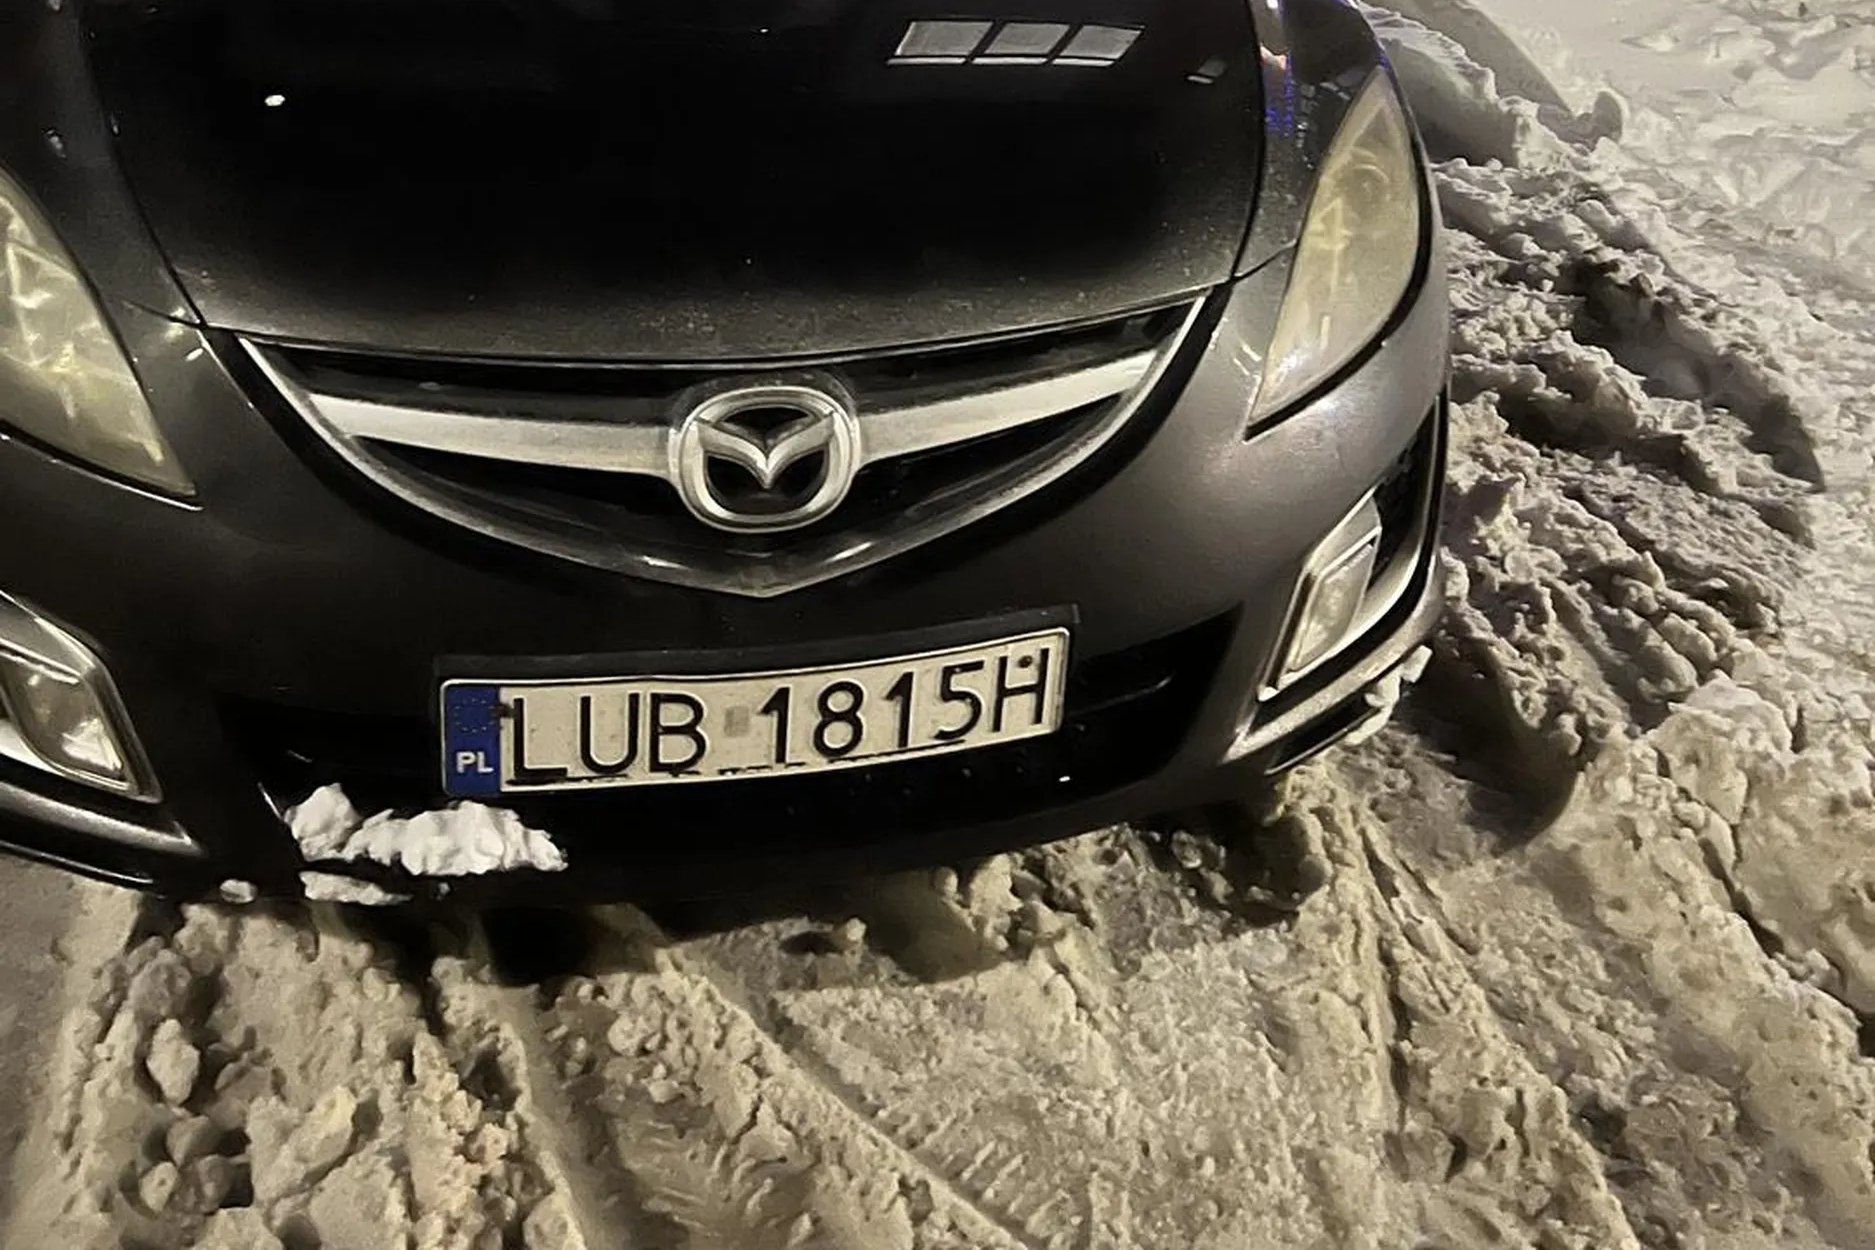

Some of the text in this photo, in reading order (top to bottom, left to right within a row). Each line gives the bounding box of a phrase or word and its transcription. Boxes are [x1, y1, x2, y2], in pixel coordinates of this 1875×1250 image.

[512, 646, 1052, 779] LUB 1815H
[456, 751, 495, 773] PL
